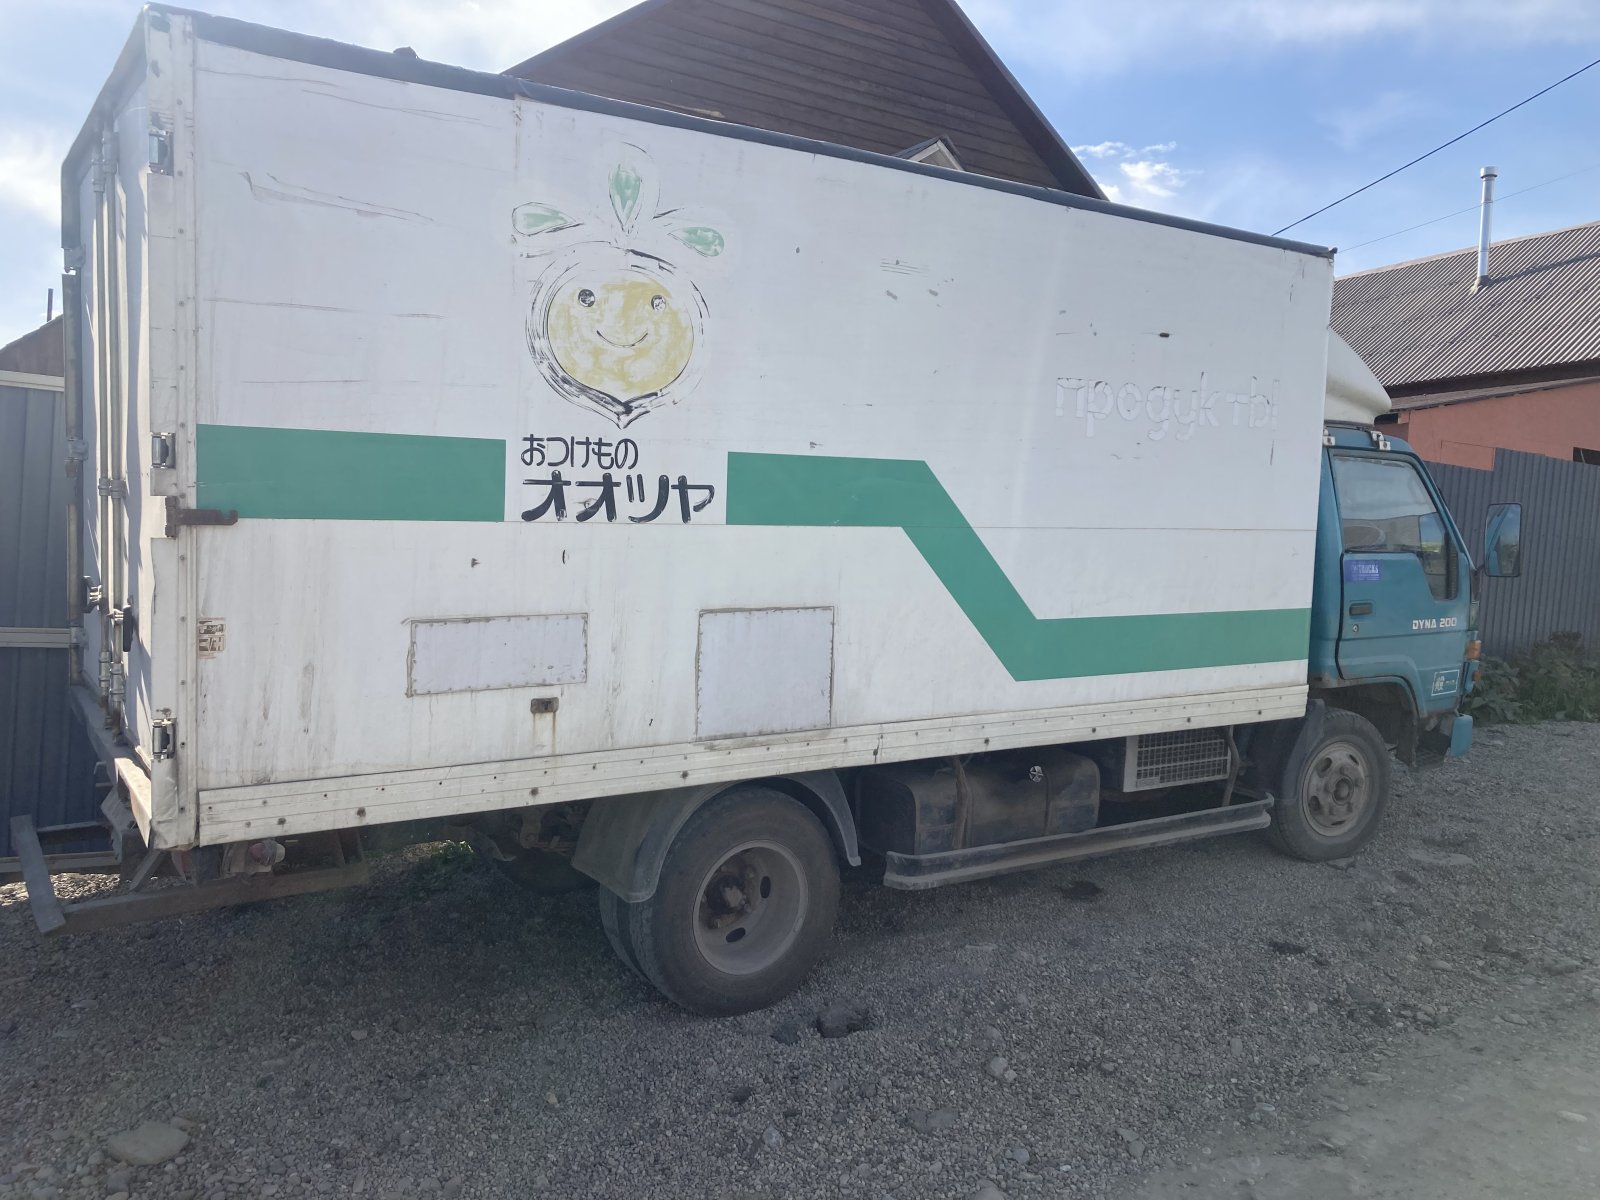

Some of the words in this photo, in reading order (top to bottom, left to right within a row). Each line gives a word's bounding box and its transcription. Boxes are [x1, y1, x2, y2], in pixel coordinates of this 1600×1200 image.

[520, 433, 639, 470] おつけもの
[520, 469, 715, 524] オオツヤ
[1412, 618, 1437, 630] DYNA
[1439, 617, 1457, 628] 200
